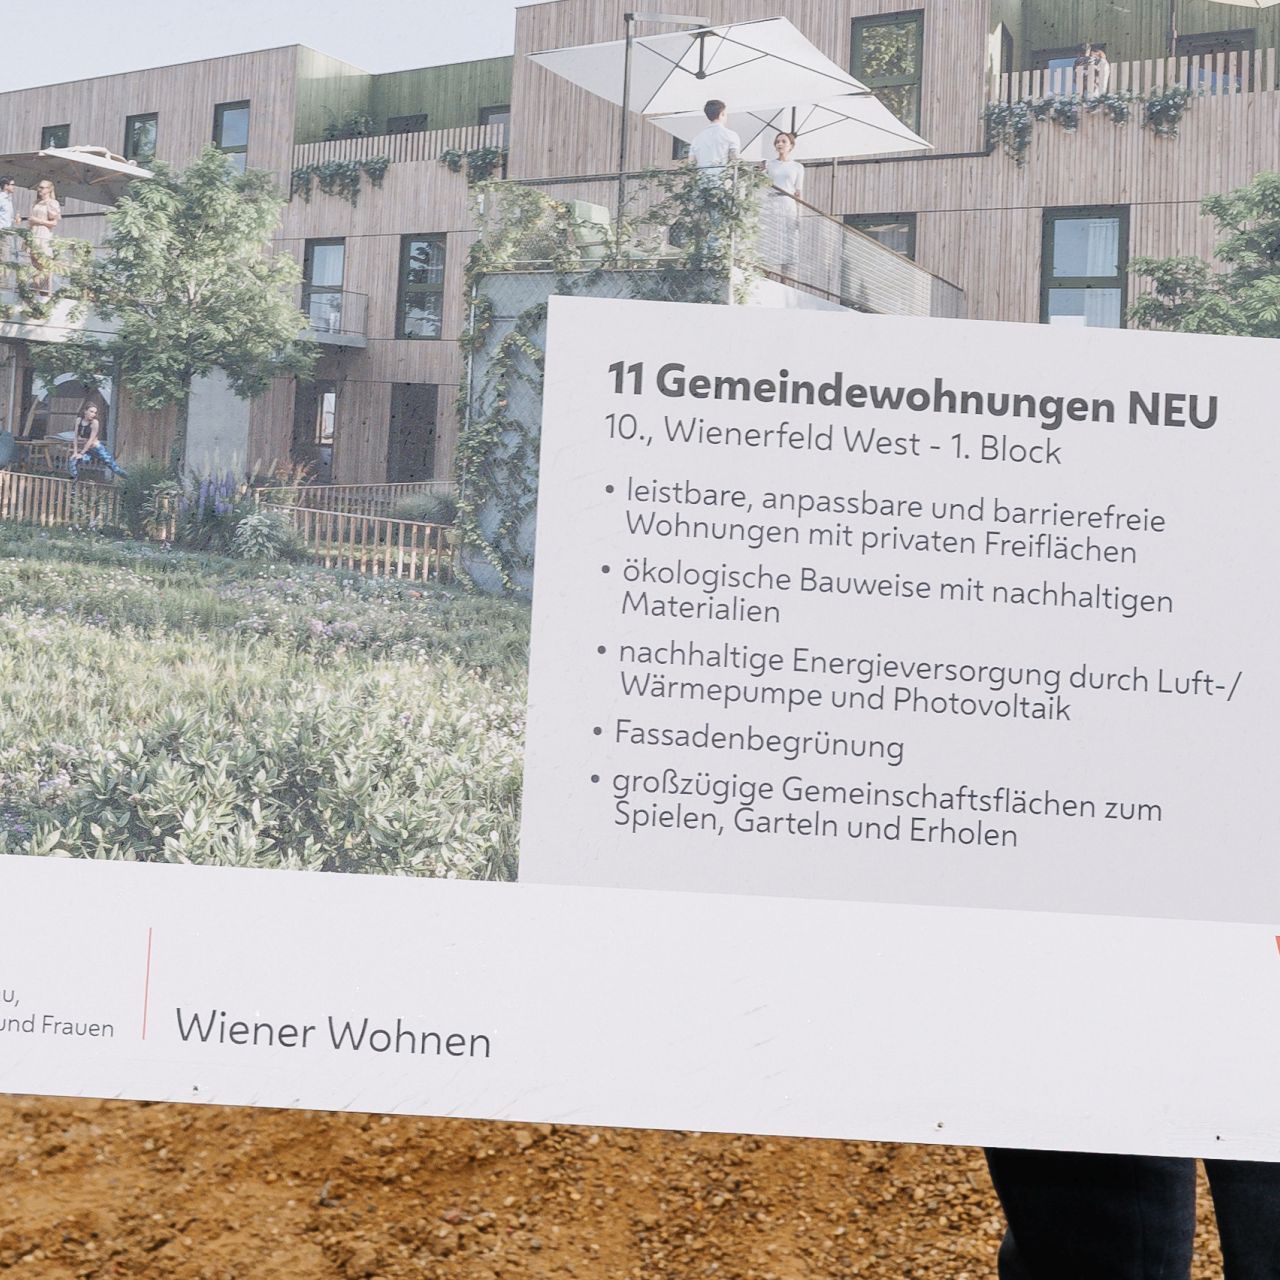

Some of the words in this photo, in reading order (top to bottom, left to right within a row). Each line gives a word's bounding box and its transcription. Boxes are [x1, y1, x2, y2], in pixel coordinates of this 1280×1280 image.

[608, 361, 643, 395] 11
[656, 363, 1114, 430] Gemeindewohnungen
[1129, 391, 1218, 429] NEU
[605, 413, 652, 446] 10.,
[665, 416, 832, 450] Wienerfeld
[844, 426, 920, 456] West
[952, 434, 969, 459] 1.
[981, 435, 1061, 464] Block
[628, 476, 752, 513] leistbare,
[763, 490, 922, 518] anpassbare
[932, 497, 984, 521] und
[994, 498, 1165, 532] barrierefreie
[626, 510, 798, 549] Wohnungen
[810, 523, 853, 546] mit
[862, 526, 975, 555] privaten
[986, 531, 1136, 563] Freiflächen
[622, 591, 779, 623] Materialien
[624, 557, 791, 602] ökologische
[801, 568, 930, 598] Bauweise
[941, 578, 984, 601] mit
[993, 581, 1172, 618] nachhaltigen
[620, 640, 783, 677] nachhaltige
[794, 648, 1061, 694] Energieversorgung
[1070, 664, 1147, 692] durch
[1159, 669, 1242, 701] Luft-/
[621, 671, 822, 712] Wärmepumpe
[832, 685, 884, 710] und
[895, 687, 1070, 720] Photovoltaik
[616, 719, 904, 766] Fassadenbegrünung
[613, 769, 773, 806] großzügige
[783, 776, 1095, 817] Gemeinschaftsflächen
[1105, 802, 1161, 821] zum
[615, 800, 723, 836] Spielen,
[734, 807, 837, 836] Garteln
[848, 815, 900, 840] und
[911, 817, 1016, 847] Erholen
[42, 1015, 114, 1037] Frauen
[176, 1008, 316, 1048] Wiener
[327, 1016, 491, 1058] Wohnen
